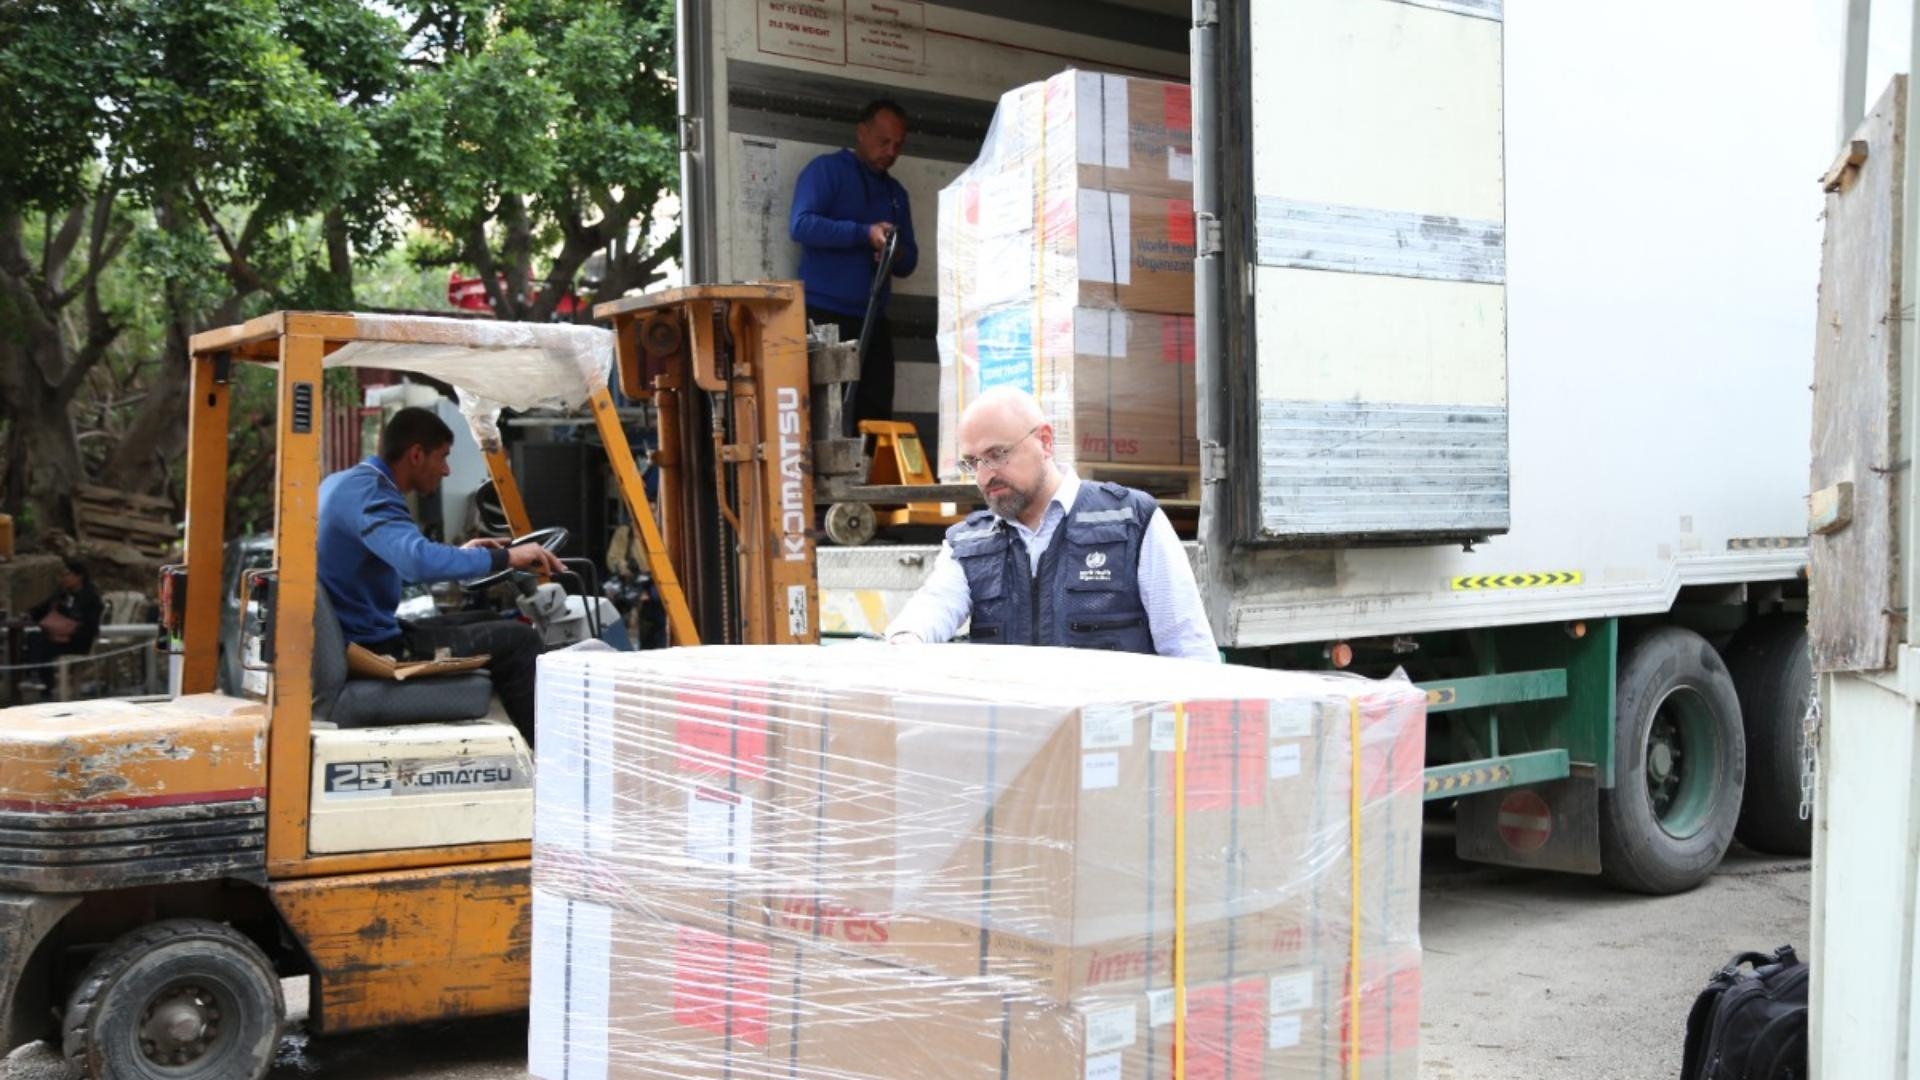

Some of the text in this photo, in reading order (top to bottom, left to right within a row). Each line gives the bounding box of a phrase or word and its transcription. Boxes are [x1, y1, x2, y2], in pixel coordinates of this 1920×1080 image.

[1083, 432, 1139, 456] imres
[778, 387, 806, 561] KOMATSU
[332, 763, 387, 792] 25
[782, 890, 889, 943] imres
